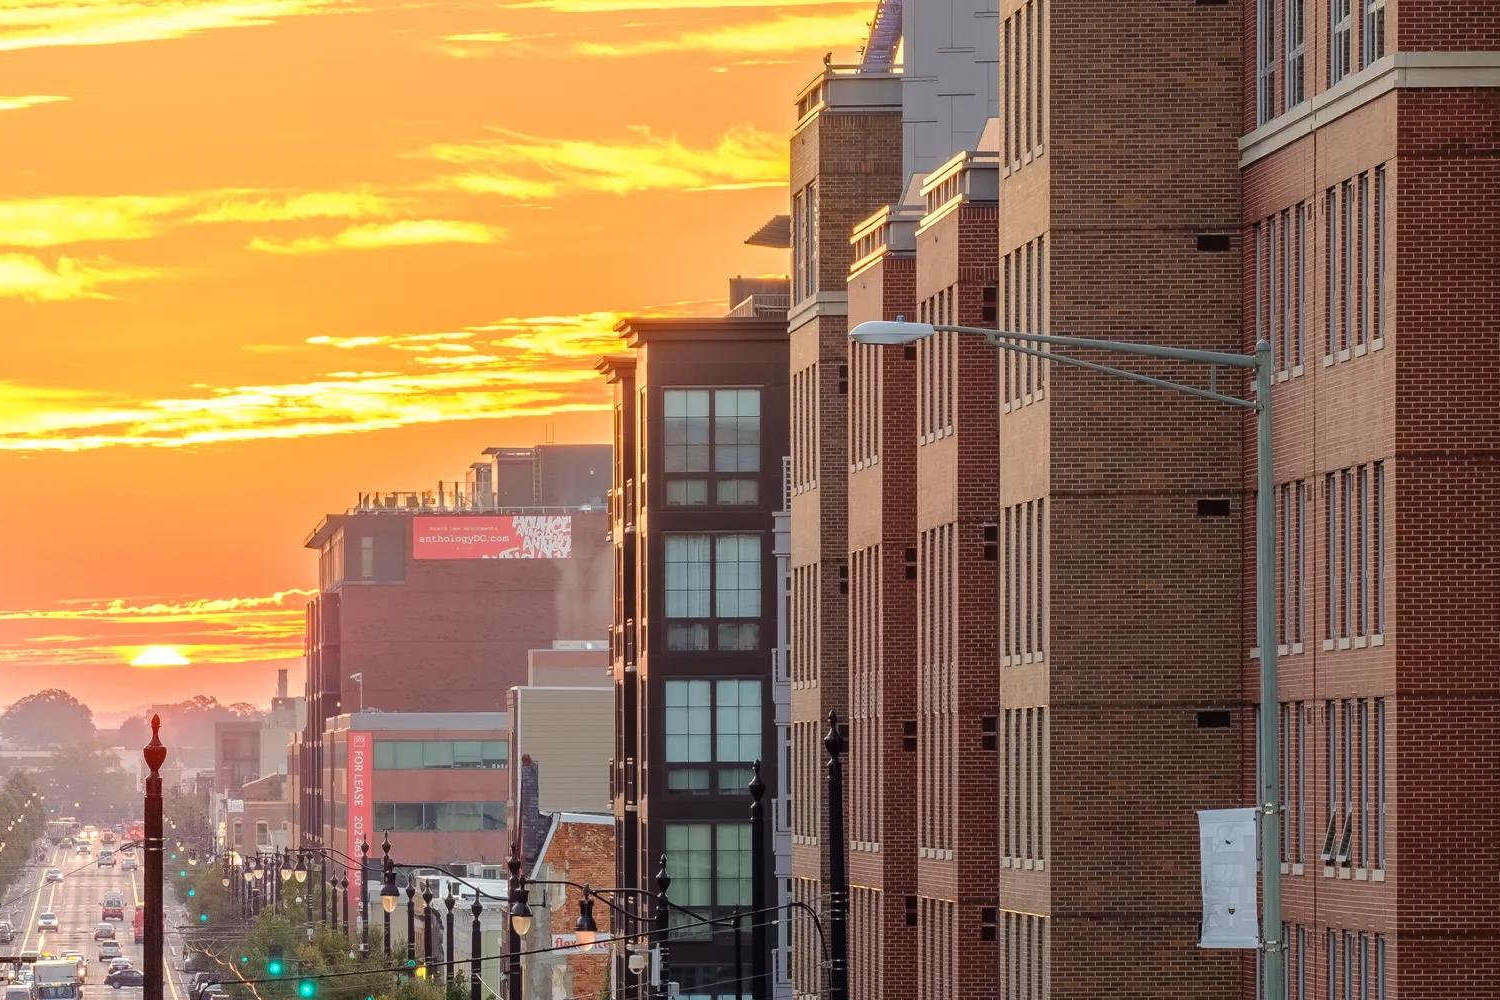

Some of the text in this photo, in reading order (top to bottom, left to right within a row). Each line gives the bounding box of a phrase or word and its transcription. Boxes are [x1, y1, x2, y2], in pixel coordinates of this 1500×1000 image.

[419, 534, 510, 545] anthologyDC.com
[353, 751, 364, 772] FOR
[353, 774, 364, 807] LEASE
